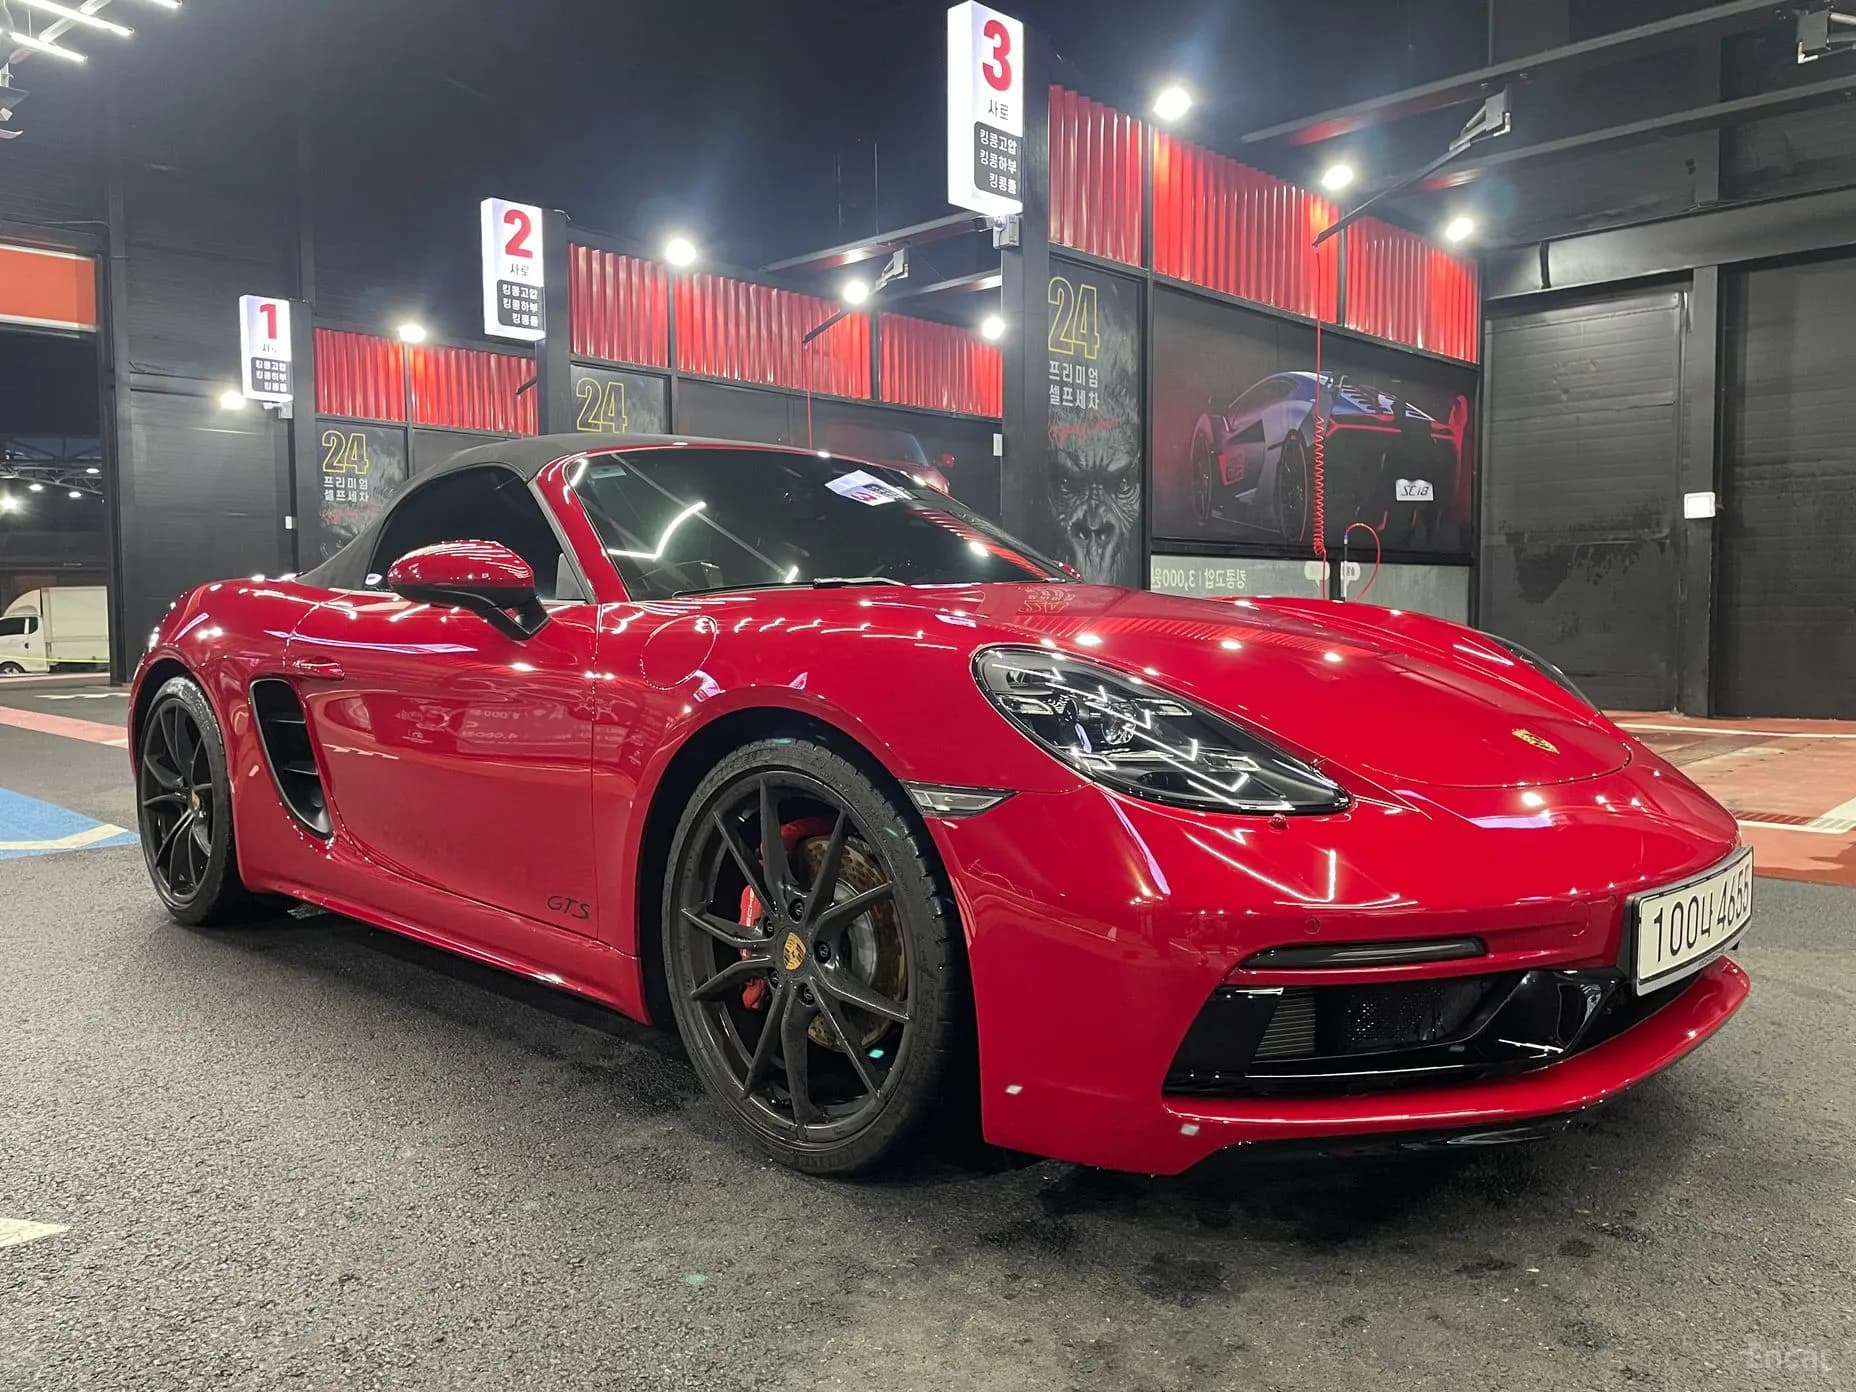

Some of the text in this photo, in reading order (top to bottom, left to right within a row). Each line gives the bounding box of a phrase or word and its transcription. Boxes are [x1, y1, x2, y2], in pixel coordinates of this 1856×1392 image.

[982, 19, 1012, 91] 3
[979, 128, 1017, 155] 킹콩고압
[979, 149, 1017, 174] 킹콩하부
[504, 209, 533, 258] 2
[259, 303, 277, 340] 1
[1048, 276, 1100, 360] 24
[1049, 360, 1099, 389] 프리미엄
[576, 377, 628, 433] 24
[1048, 385, 1100, 410] 셀프세차
[321, 430, 369, 475] 24
[323, 475, 368, 490] 프리미엄
[547, 895, 590, 920] GTS
